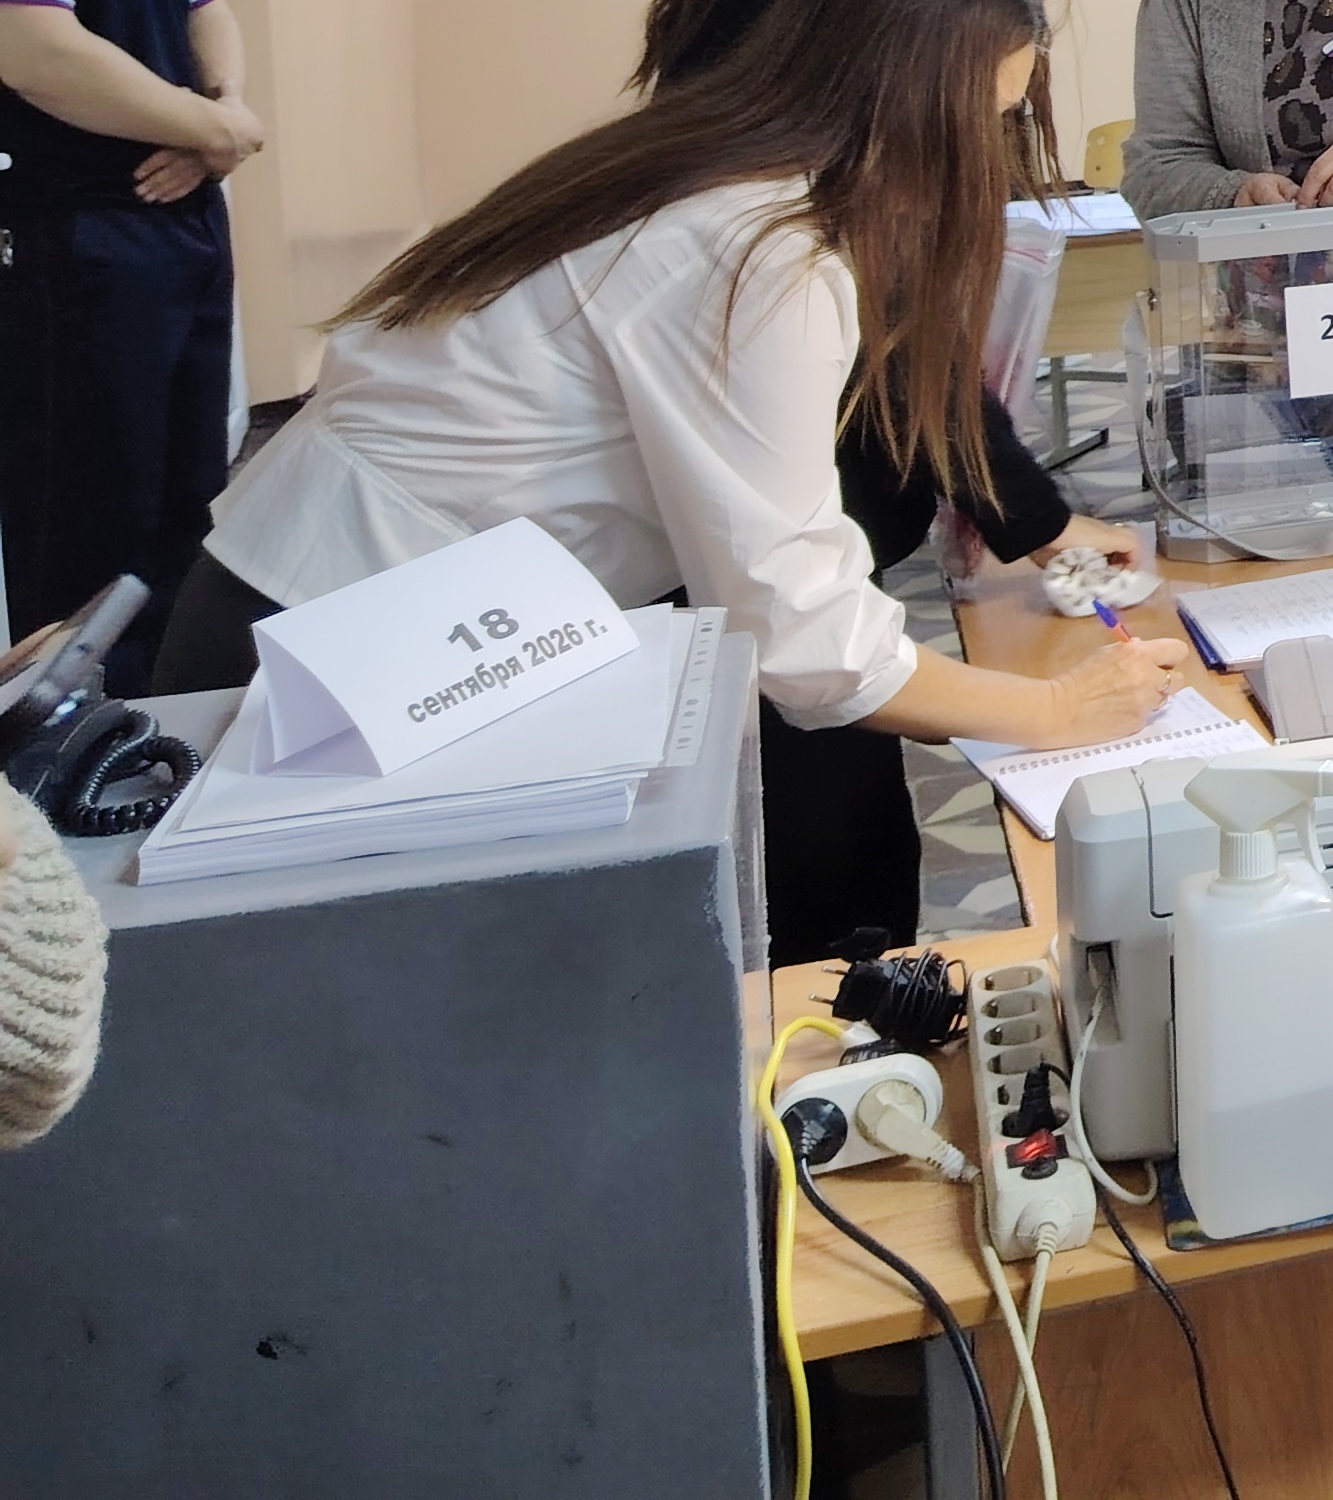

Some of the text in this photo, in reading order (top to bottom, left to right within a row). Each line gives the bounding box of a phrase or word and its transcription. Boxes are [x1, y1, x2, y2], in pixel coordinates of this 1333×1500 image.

[447, 608, 519, 652] 18
[407, 619, 609, 723] сентября 2026 г.
